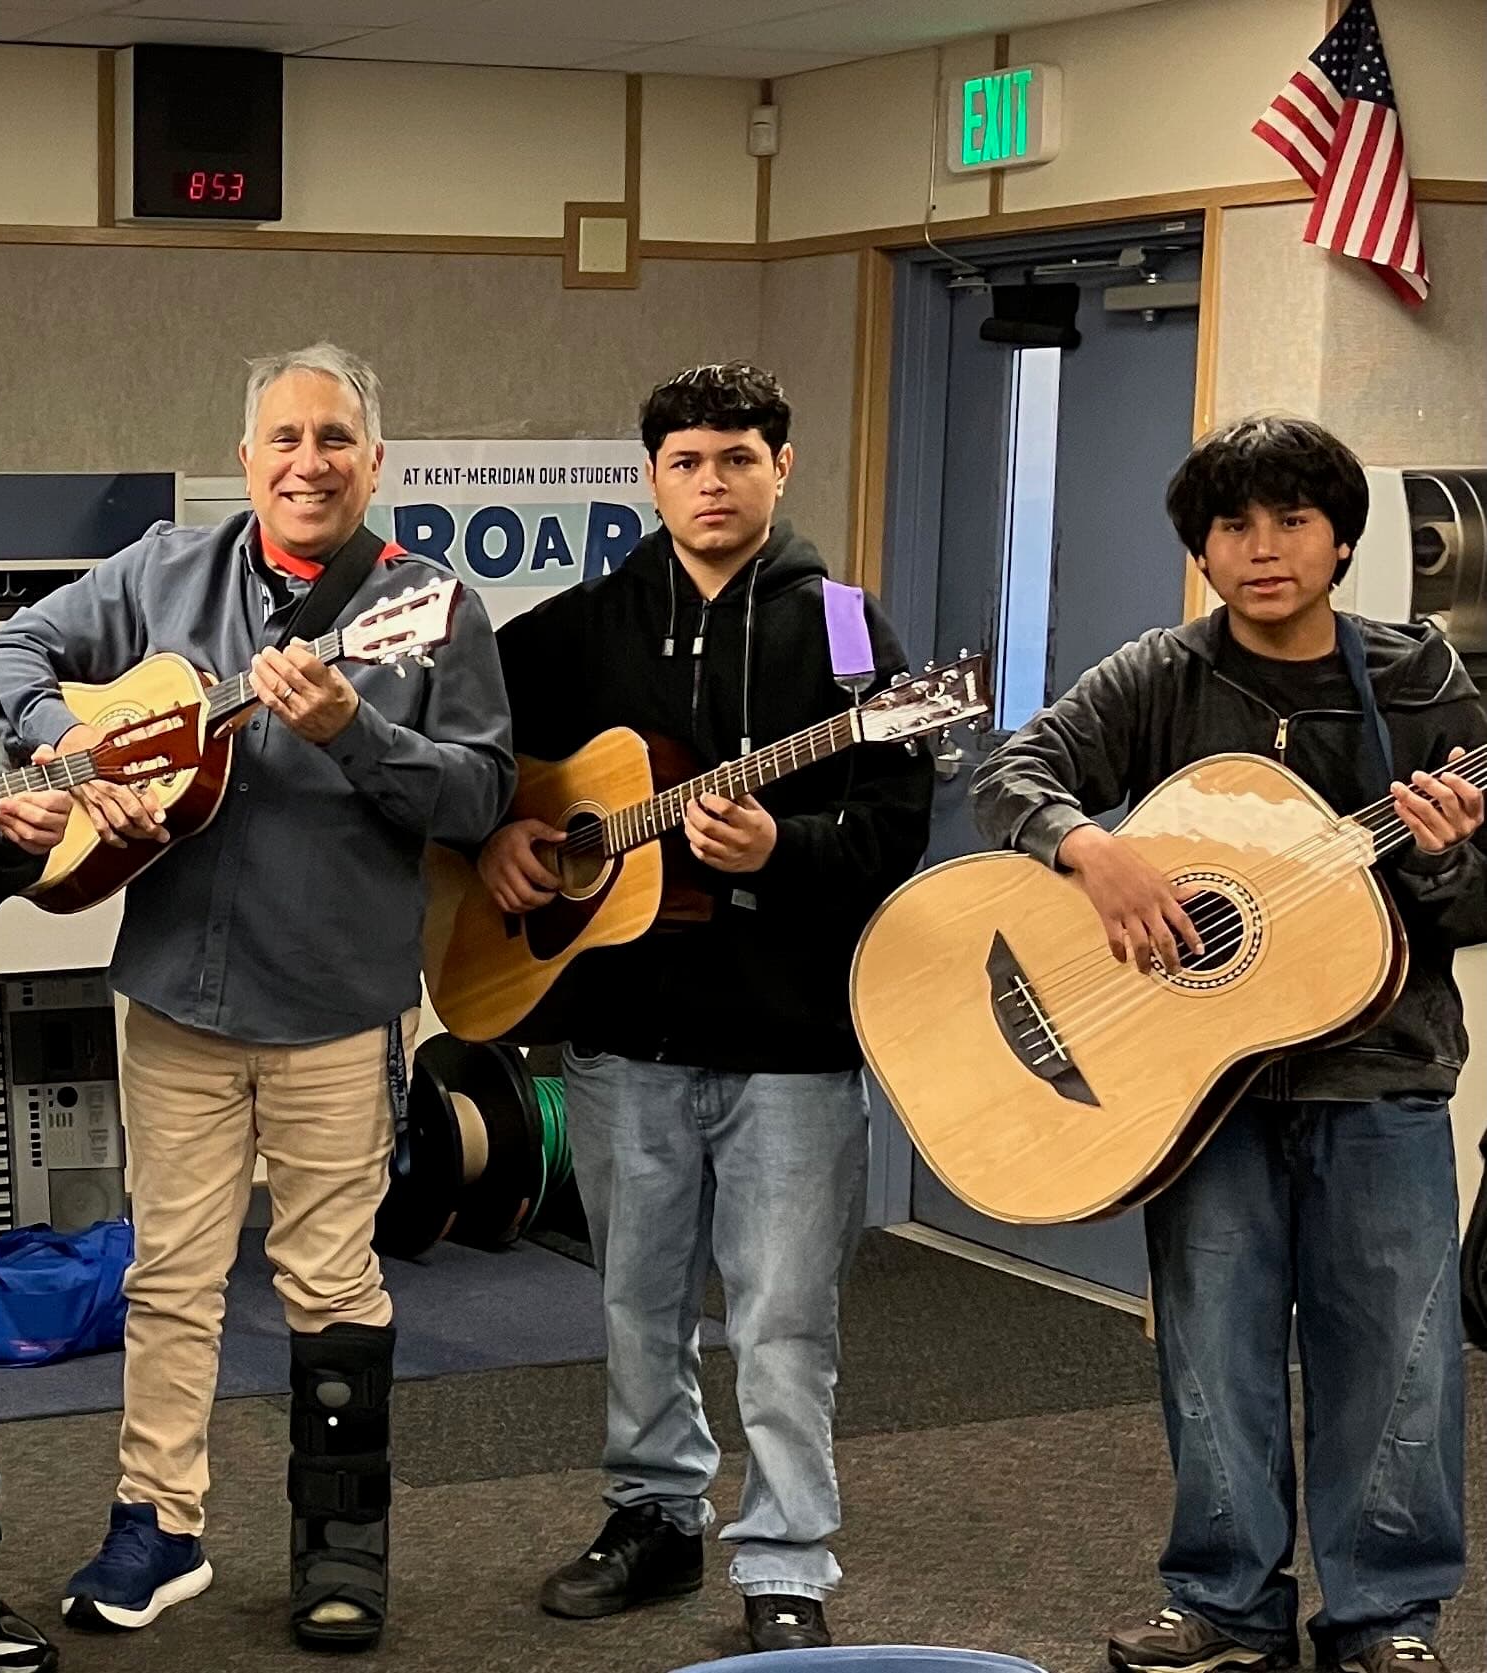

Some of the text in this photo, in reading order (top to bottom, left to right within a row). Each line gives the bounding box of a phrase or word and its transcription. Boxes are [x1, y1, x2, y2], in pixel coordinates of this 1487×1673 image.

[963, 69, 1032, 165] EXIT
[189, 171, 244, 201] 853
[403, 466, 639, 486] AT KENT-MERIDIAN OUR STUDENTS
[394, 501, 643, 583] ROAR
